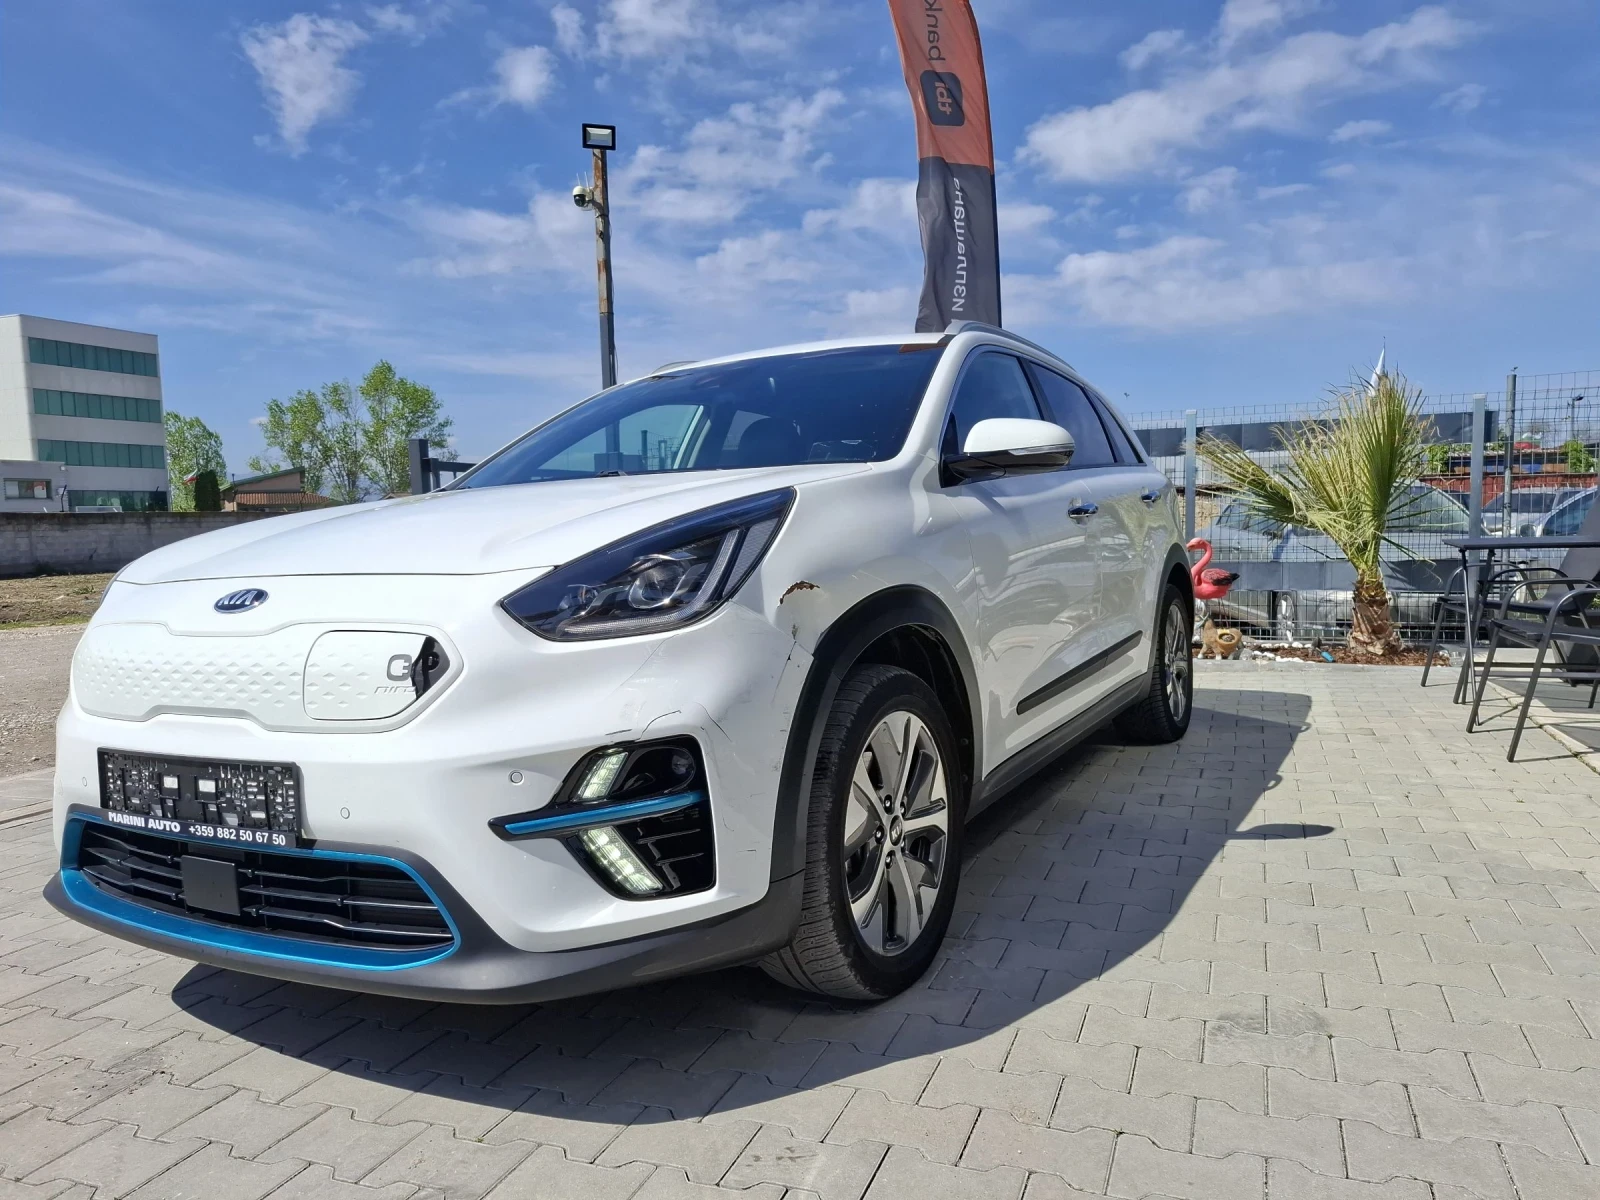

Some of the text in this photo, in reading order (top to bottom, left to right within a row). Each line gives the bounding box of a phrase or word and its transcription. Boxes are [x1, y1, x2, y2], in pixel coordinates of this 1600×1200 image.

[108, 811, 286, 846] MARINI AUTO +359 882 50 67 50
